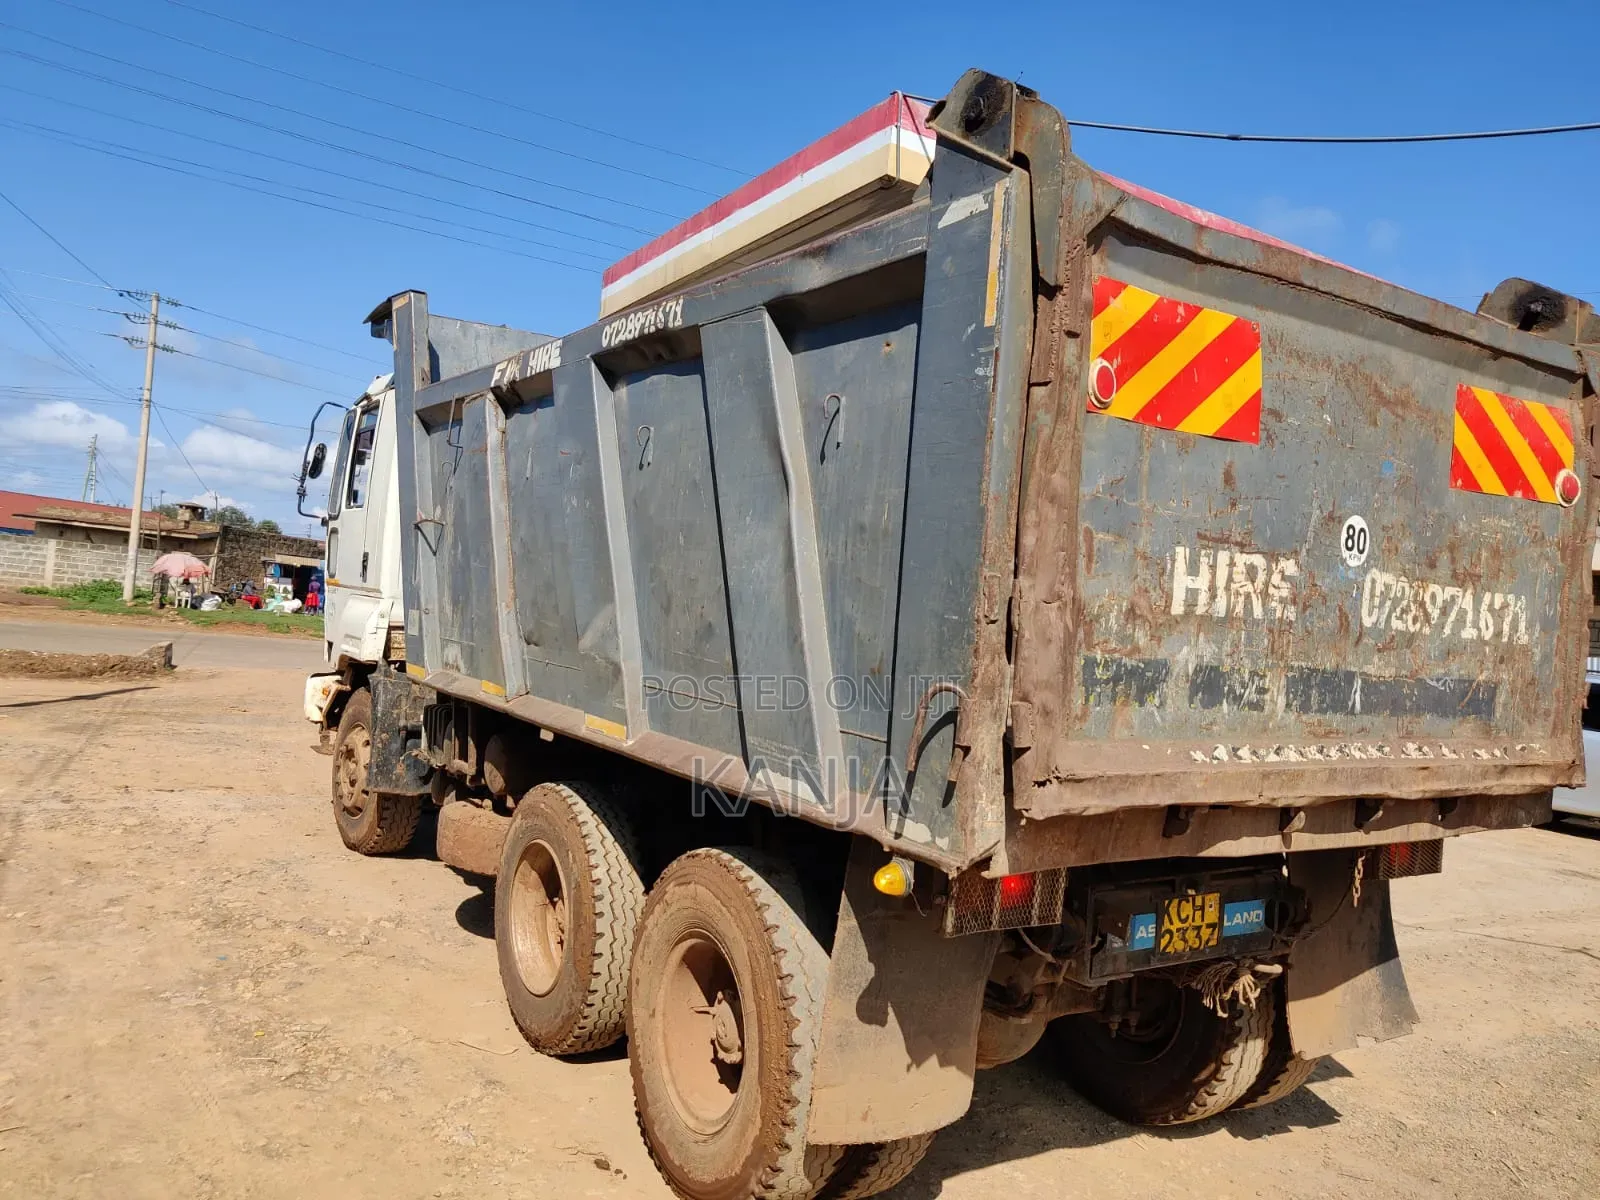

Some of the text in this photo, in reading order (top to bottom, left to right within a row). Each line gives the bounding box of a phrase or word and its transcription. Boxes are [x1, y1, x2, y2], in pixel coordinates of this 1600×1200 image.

[526, 339, 563, 377] HIRE
[1344, 523, 1367, 555] 80
[1171, 545, 1299, 622] HIRE
[1163, 896, 1206, 926] KCH
